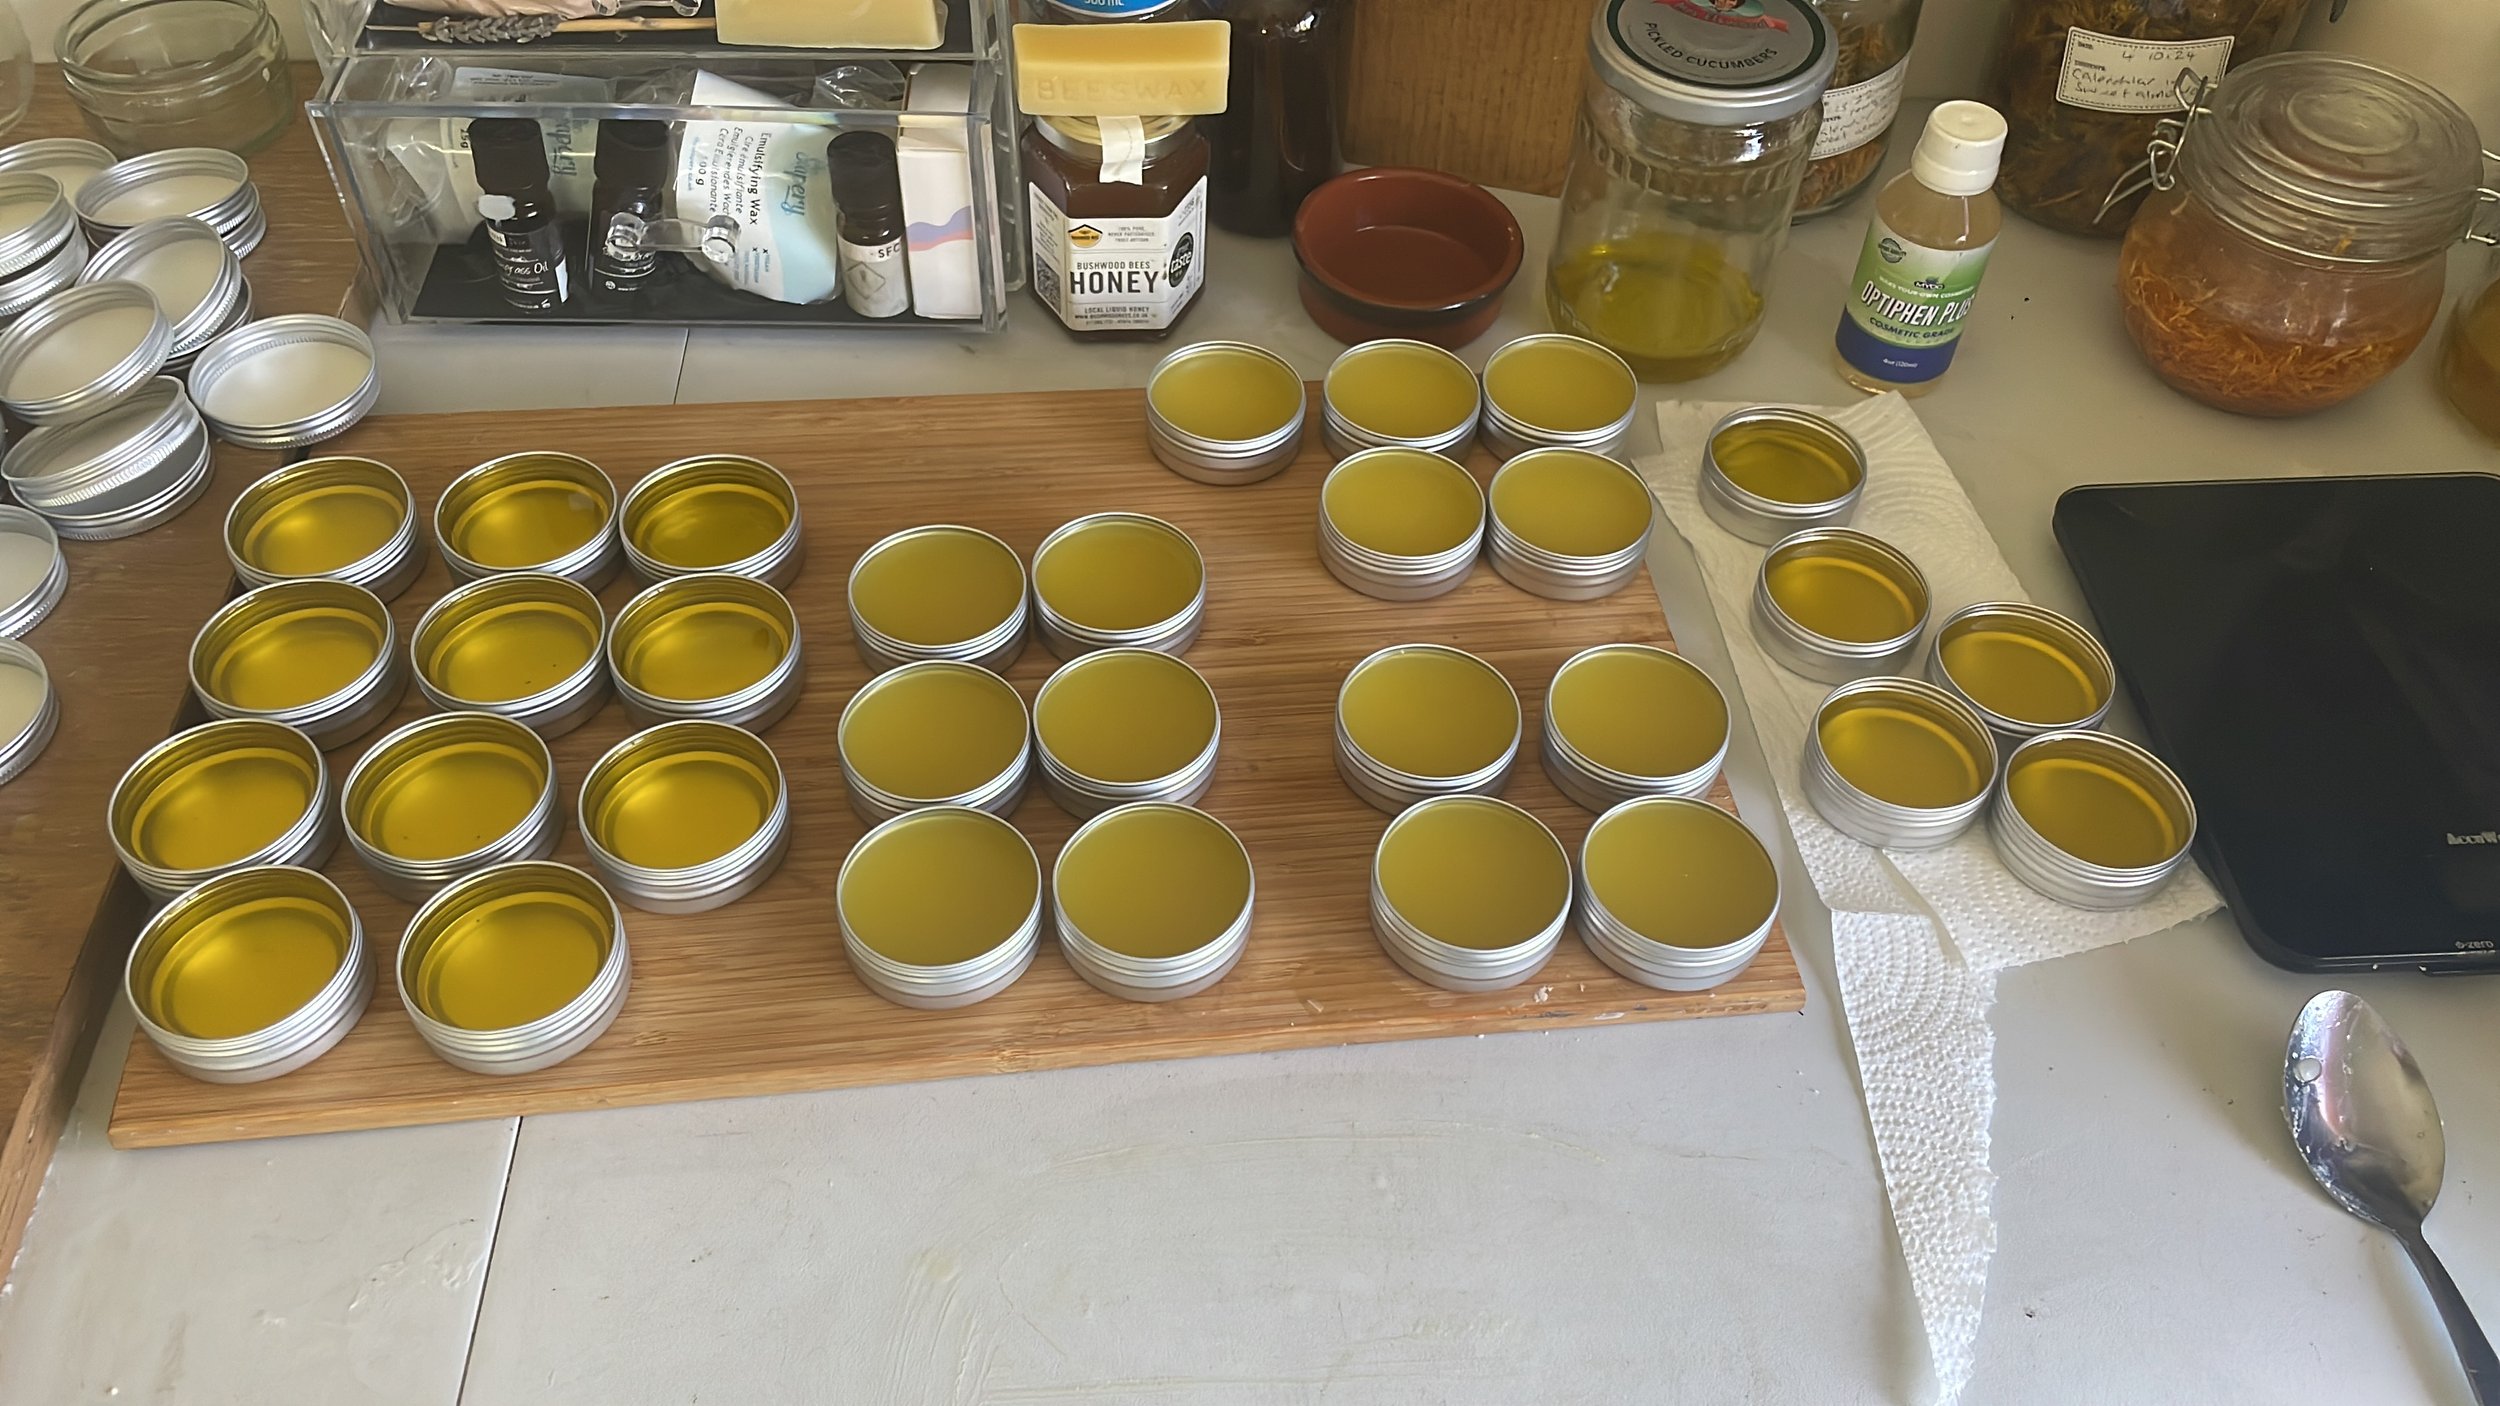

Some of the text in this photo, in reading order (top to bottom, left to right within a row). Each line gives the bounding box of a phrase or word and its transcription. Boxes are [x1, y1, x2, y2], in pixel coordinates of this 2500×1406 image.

[1645, 21, 1778, 70] PICKLED CUCUMBERS
[1038, 79, 1208, 101] BEESWAX
[747, 132, 772, 226] Emulsifying Wax
[1076, 260, 1151, 270] BUSHWOOD BEES
[1070, 271, 1159, 294] HONEY
[1861, 280, 1940, 327] OPTIPHEN
[1870, 317, 1921, 339] COSMETIC
